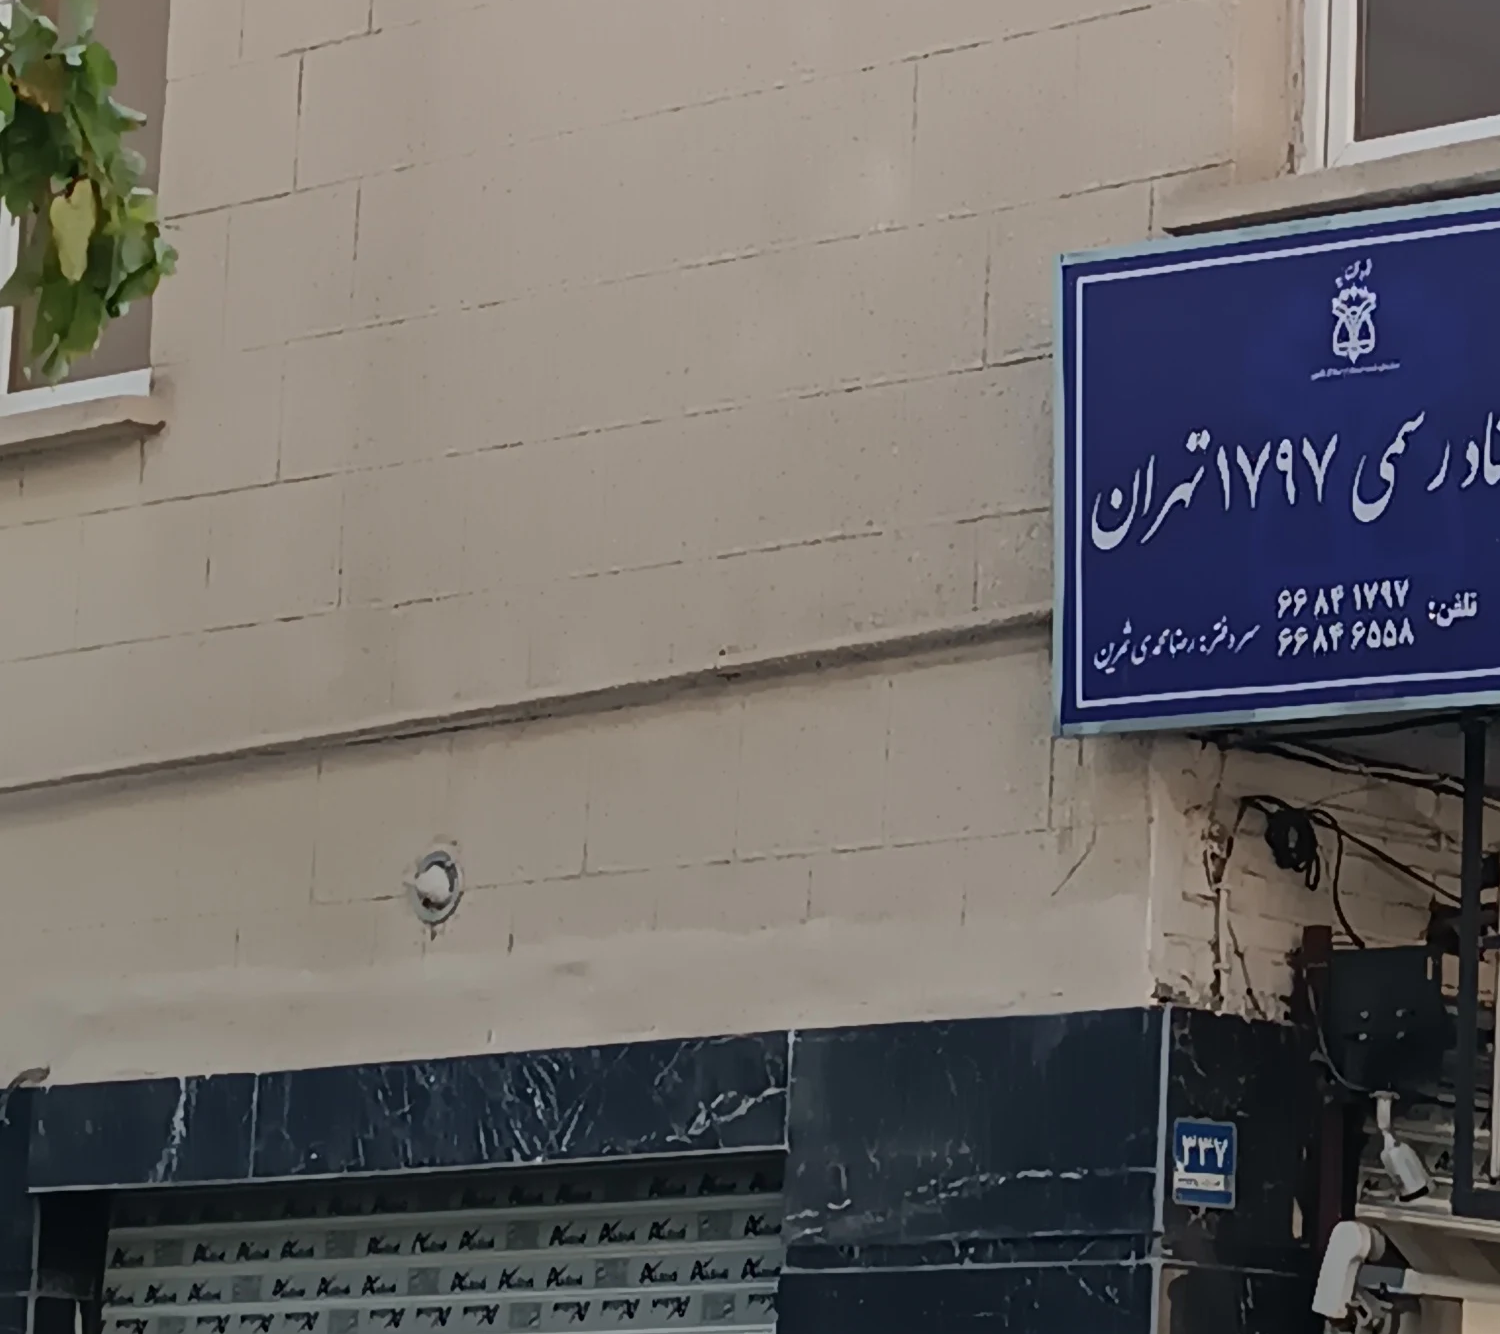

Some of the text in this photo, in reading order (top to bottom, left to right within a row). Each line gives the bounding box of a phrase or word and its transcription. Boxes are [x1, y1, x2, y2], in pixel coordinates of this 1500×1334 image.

[1091, 429, 1212, 551] تهران
[1217, 433, 1339, 512] ۱۷۹۷
[1352, 410, 1450, 523] رسمی
